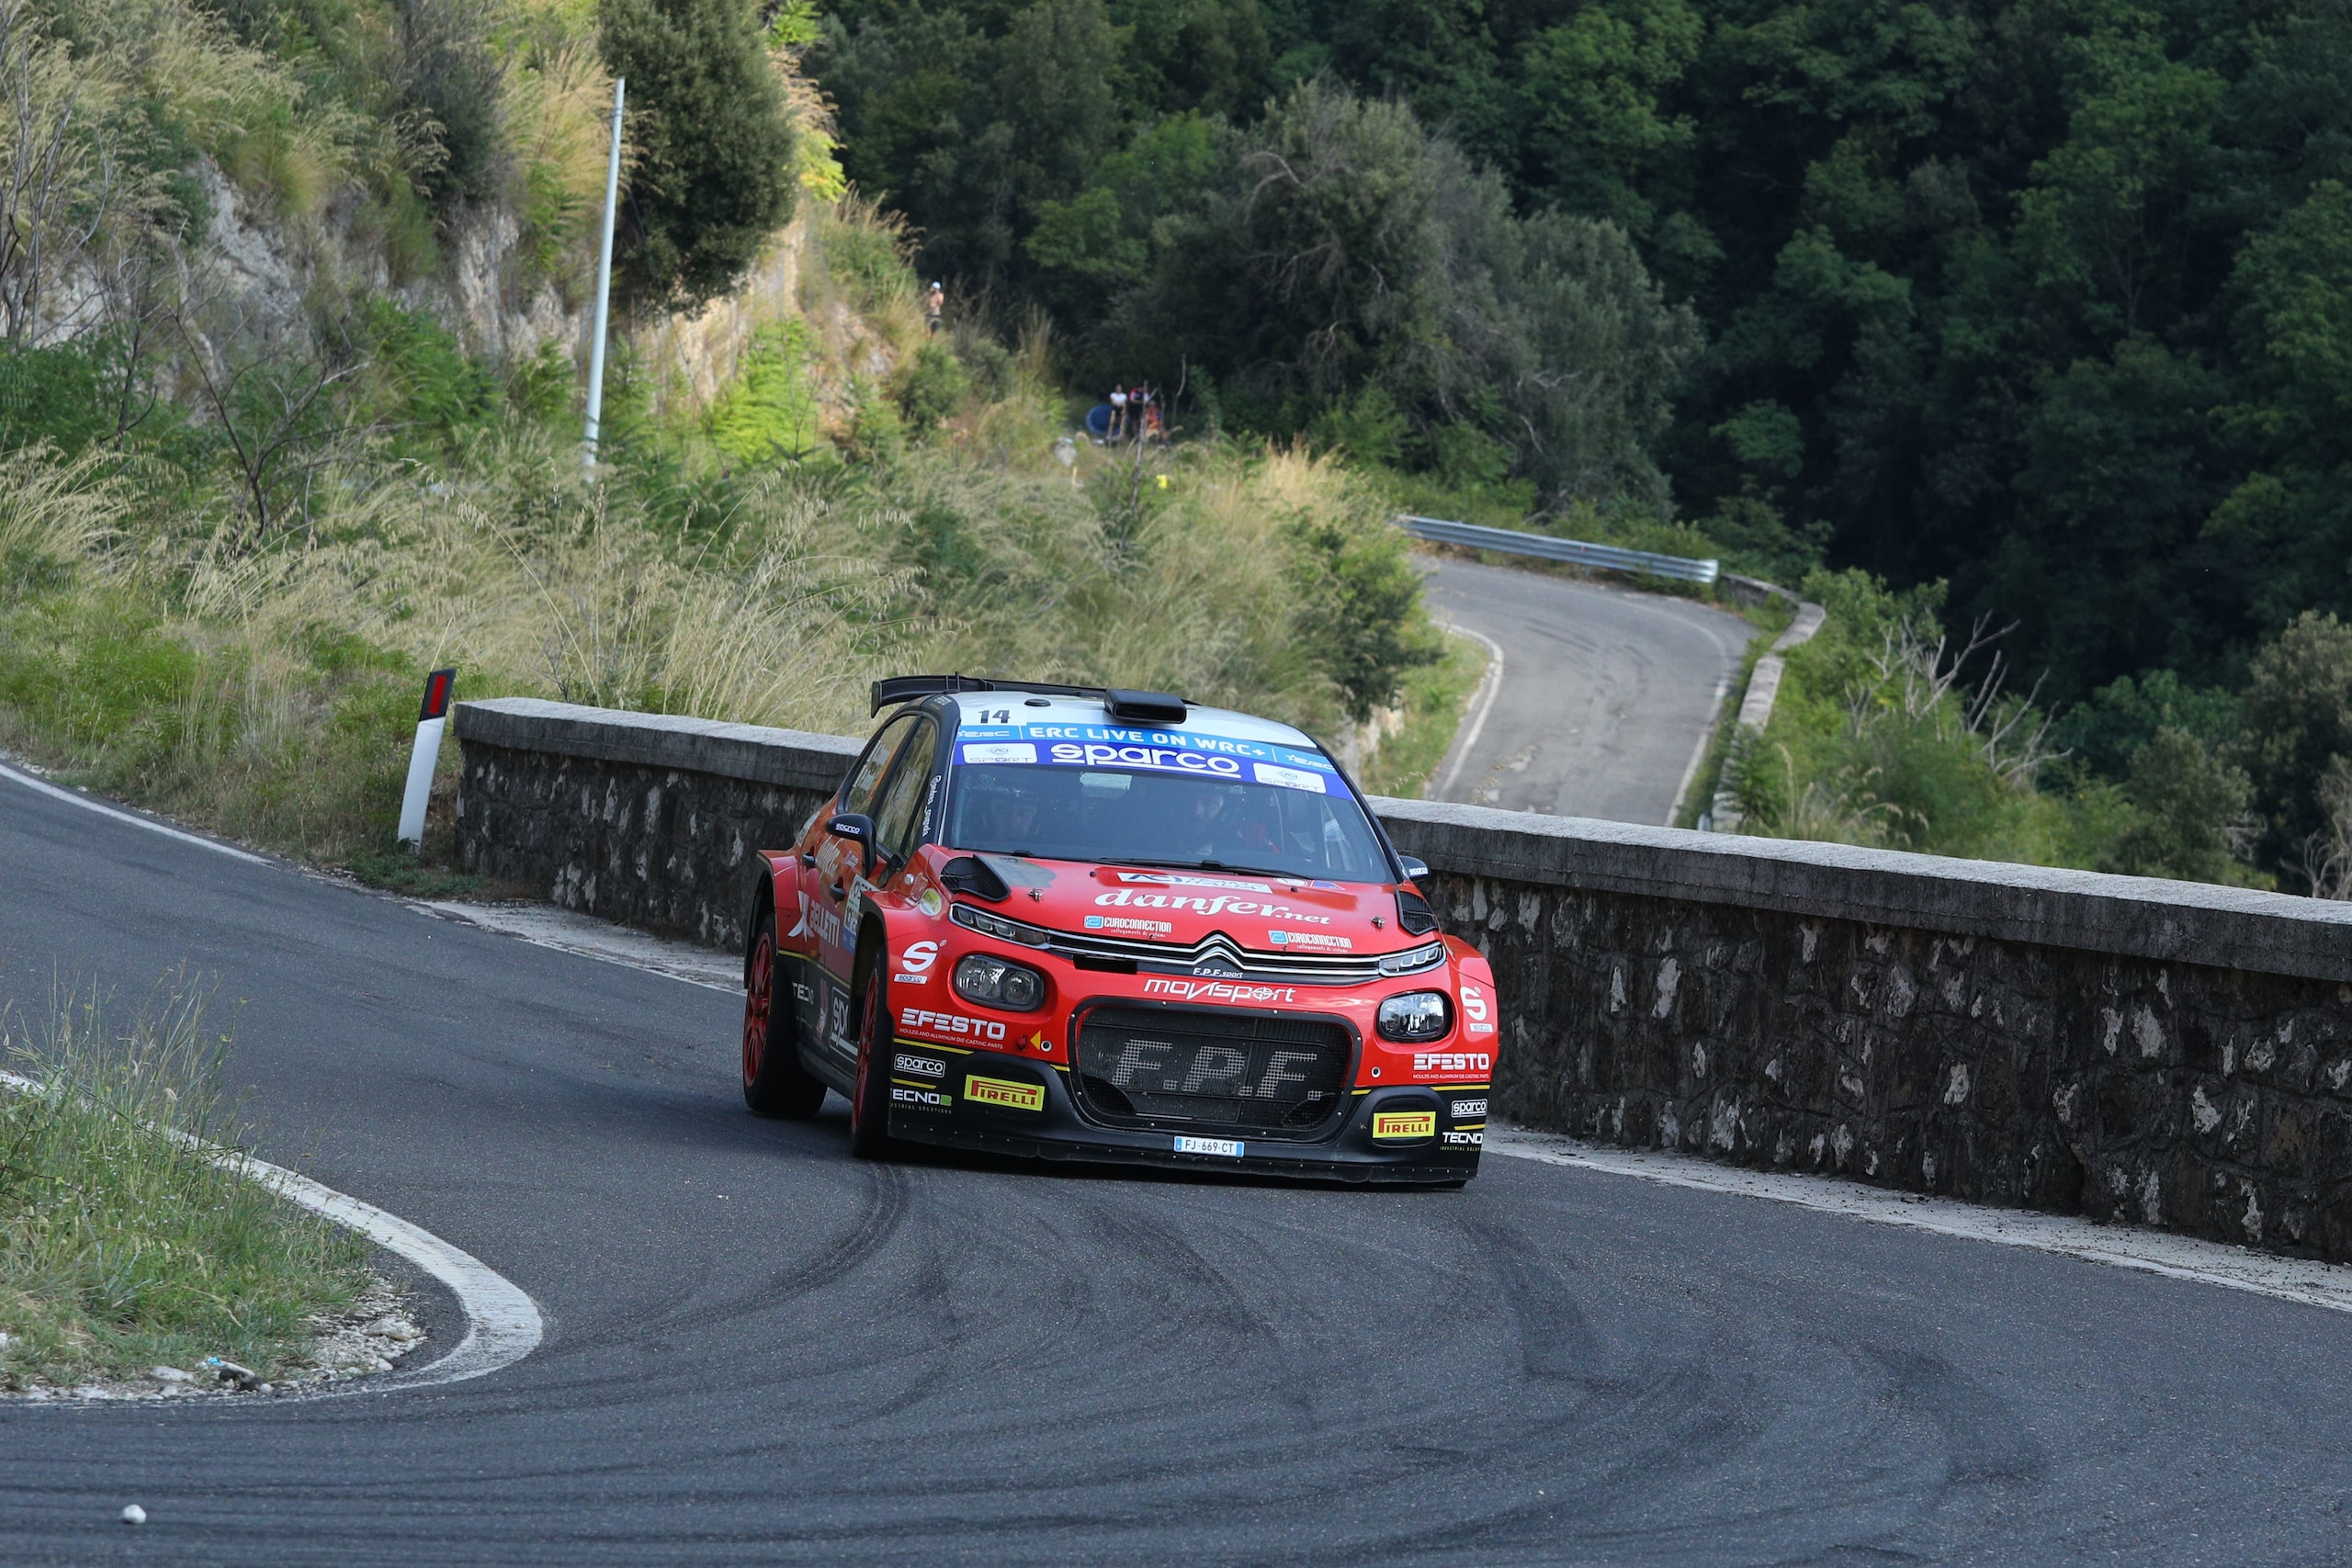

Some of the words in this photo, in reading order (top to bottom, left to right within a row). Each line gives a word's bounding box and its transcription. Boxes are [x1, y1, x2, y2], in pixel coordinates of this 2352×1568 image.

[978, 709, 1011, 724] 14
[1028, 727, 1079, 739] ERC
[1087, 728, 1144, 743] LIVE
[1152, 733, 1186, 746] ON
[1194, 737, 1266, 757] WRC+
[1050, 743, 1241, 778] sparco
[835, 823, 861, 834] sparco
[1094, 888, 1330, 925] danfer.net
[1103, 917, 1172, 933] EUROCONNECTION
[1287, 931, 1352, 949] EUROCONNECTION
[899, 975, 922, 983] sparco
[900, 1008, 1006, 1040] EFESTO
[899, 1028, 919, 1036] MOULDS
[956, 1037, 987, 1047] DIE-CASTING
[896, 1055, 944, 1075] sparco
[1413, 1054, 1489, 1070] EFESTO
[971, 1079, 1038, 1106] PIRELLI
[1453, 1100, 1487, 1116] sparco
[1378, 1116, 1430, 1134] PIRELLI
[1184, 1139, 1235, 1154] FJ-669-CT
